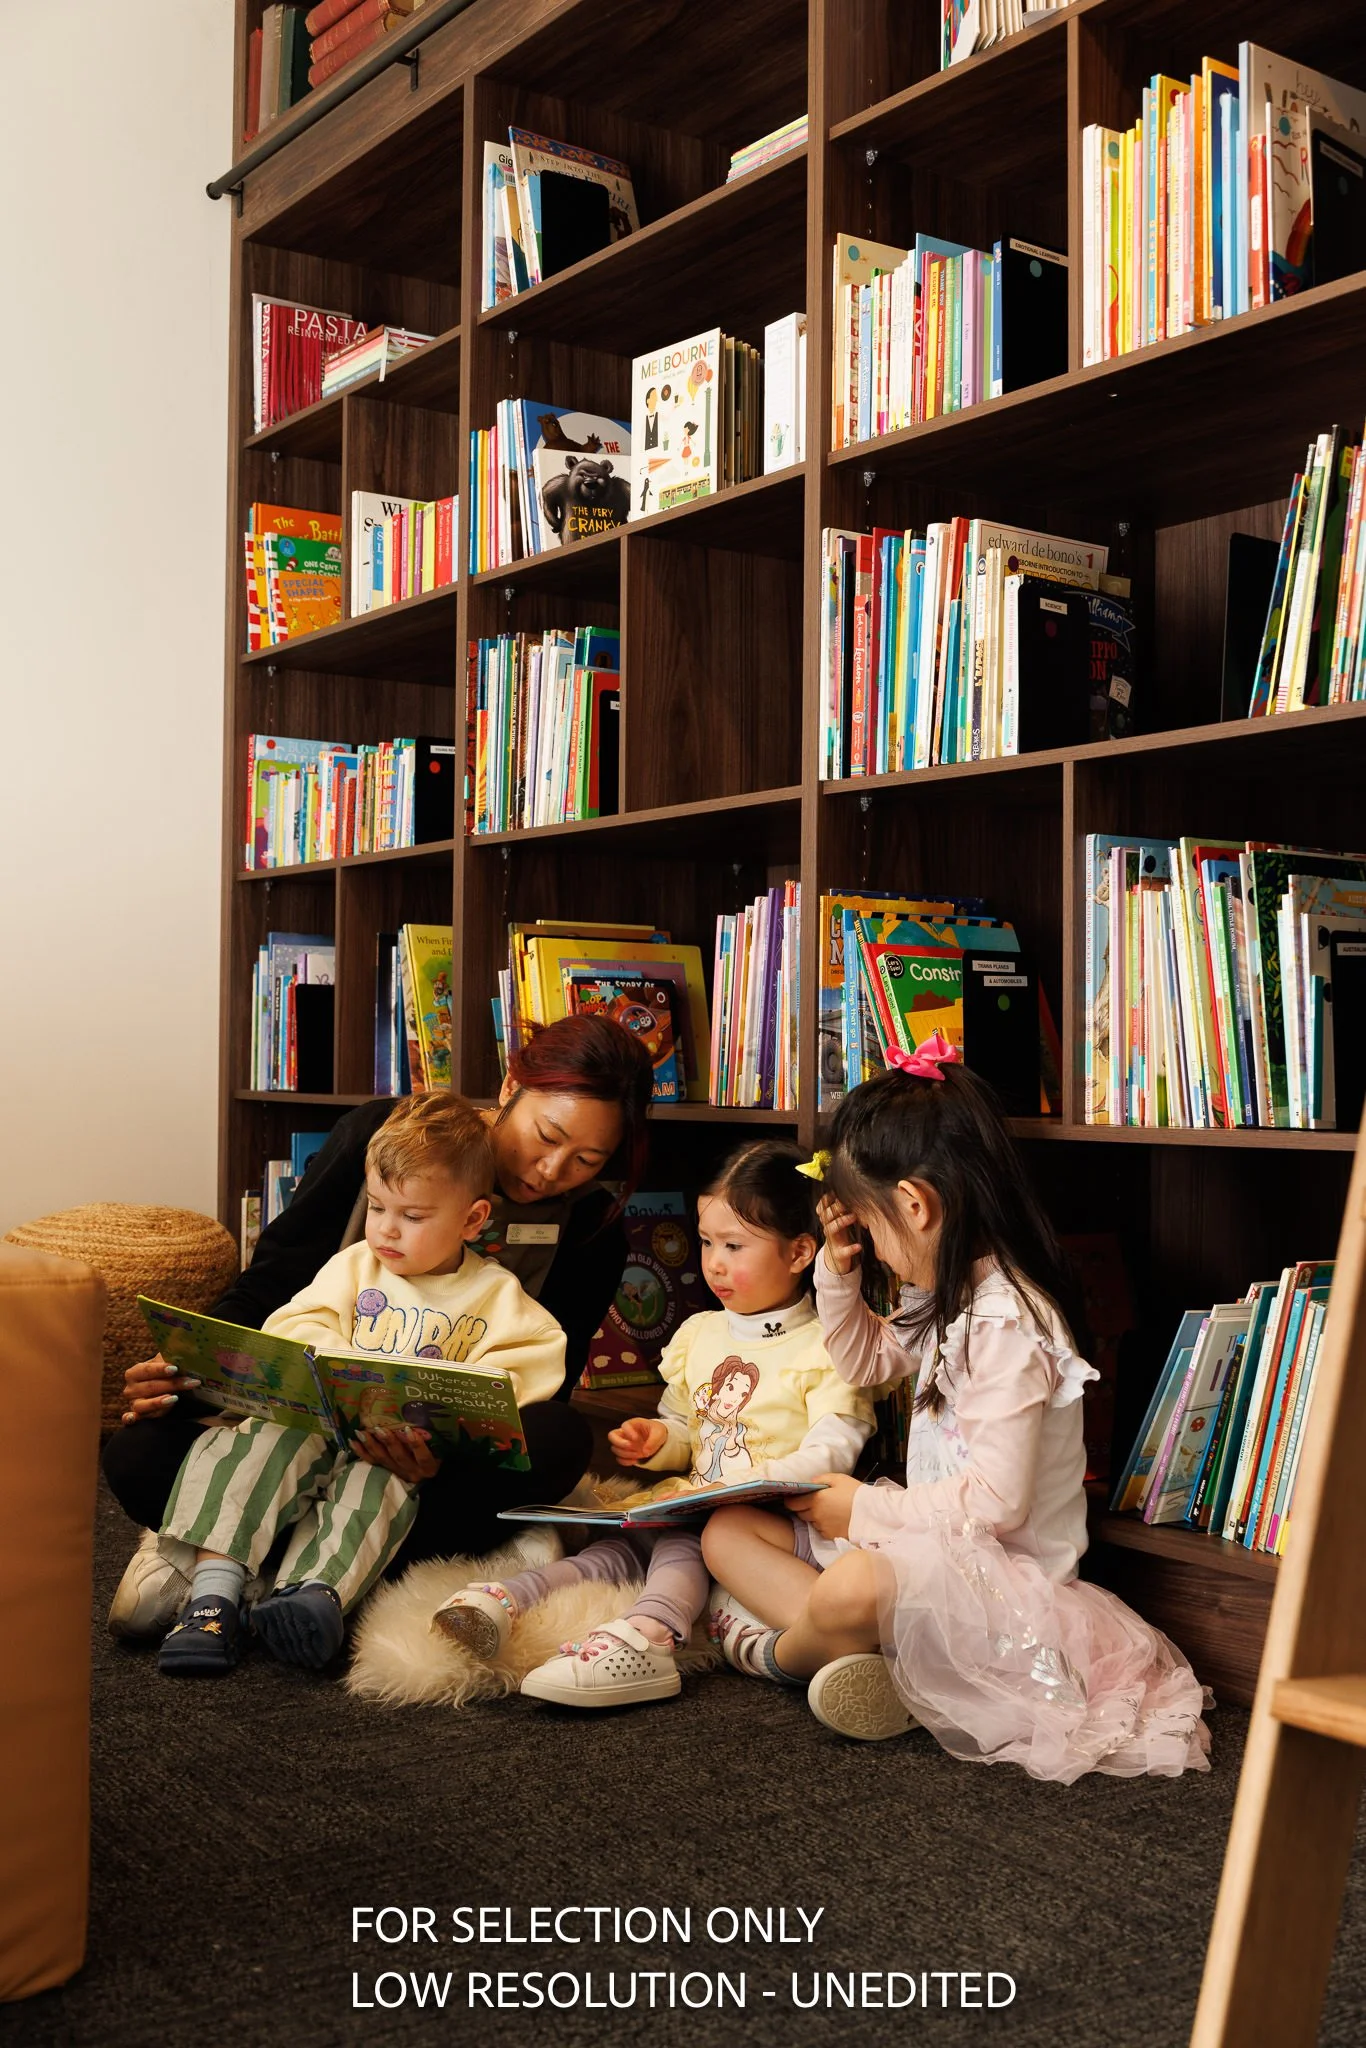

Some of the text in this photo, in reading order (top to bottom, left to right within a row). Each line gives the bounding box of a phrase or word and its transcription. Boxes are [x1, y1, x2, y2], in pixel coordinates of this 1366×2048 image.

[499, 154, 513, 167] Gig
[262, 304, 270, 359] PASTA
[294, 308, 368, 340] PASTA
[287, 325, 351, 346] REINVENTED
[641, 339, 715, 380] MELBOURNE
[604, 441, 620, 454] THE
[572, 506, 614, 518] THE VERY
[272, 516, 295, 530] The
[308, 520, 343, 542] Battl
[567, 516, 621, 533] CRANKY
[988, 534, 1094, 569] edward de bono's 1
[303, 560, 318, 568] ONE
[1017, 558, 1038, 569] SBORNE
[1038, 563, 1075, 578] INTRODUCTION
[282, 578, 324, 588] SPECIAL
[286, 587, 324, 597] SHAPES
[1044, 602, 1062, 611] SCIENCE
[1090, 640, 1117, 660] IPPO
[855, 647, 864, 685] London
[416, 935, 439, 945] When
[431, 947, 446, 956] and
[910, 963, 962, 982] Constr
[652, 1082, 675, 1097] AM
[637, 1254, 652, 1266] OLD
[652, 1260, 673, 1293] WOMAN
[608, 1304, 622, 1325] WHO
[620, 1321, 664, 1340] SWALLOWED
[417, 1370, 477, 1388] Where's
[405, 1385, 508, 1412] Dinosaur?
[429, 1382, 495, 1400] George's
[193, 1606, 222, 1618] BLUEY
